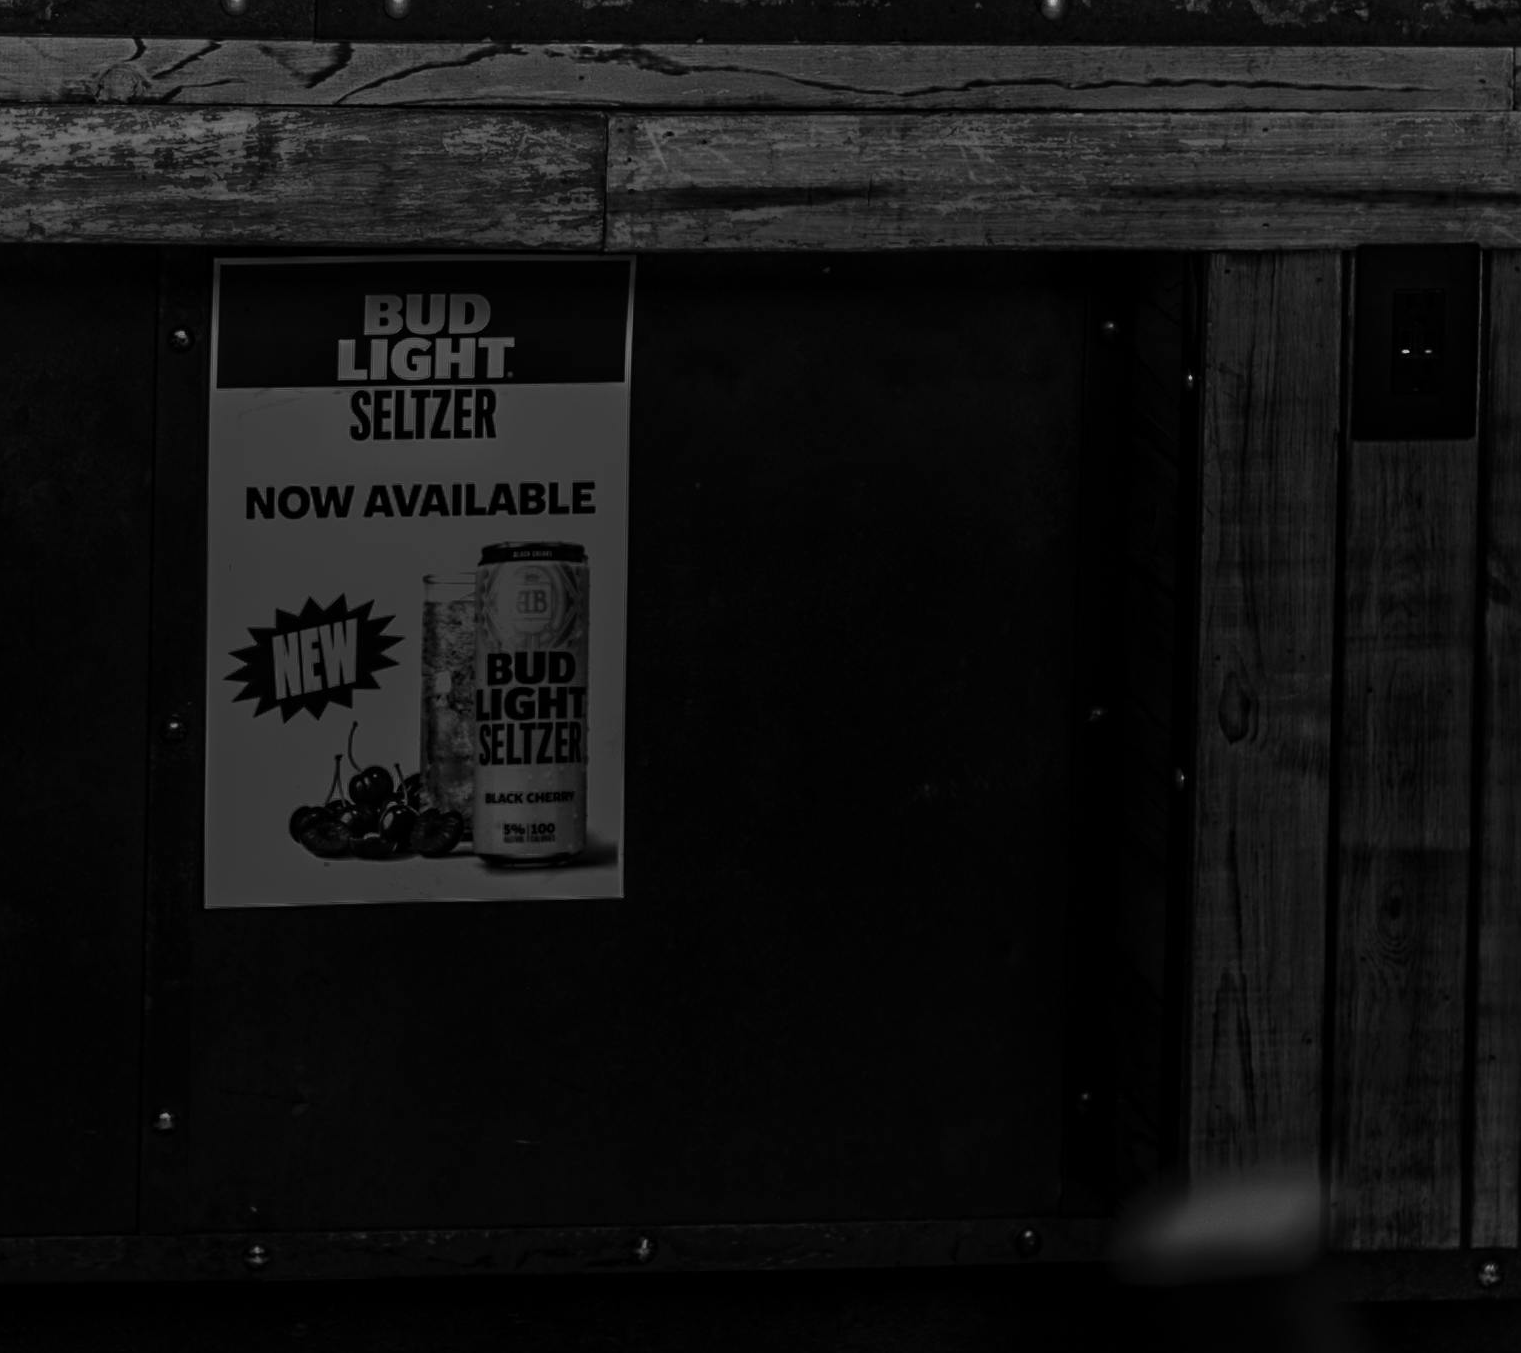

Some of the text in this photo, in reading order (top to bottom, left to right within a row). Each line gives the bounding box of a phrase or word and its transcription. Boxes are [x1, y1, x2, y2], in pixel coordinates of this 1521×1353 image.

[363, 293, 492, 337] BUD
[337, 335, 516, 382] LIGHT
[349, 388, 497, 442] SELTZER
[246, 481, 596, 520] NOW AVAILABLE
[270, 618, 360, 702] NEW
[486, 650, 576, 686] BUD
[475, 685, 587, 722] LIGHT
[478, 721, 582, 767] SELTZER
[485, 790, 576, 805] BLACK CHERRY
[503, 822, 556, 836] 5% 100
